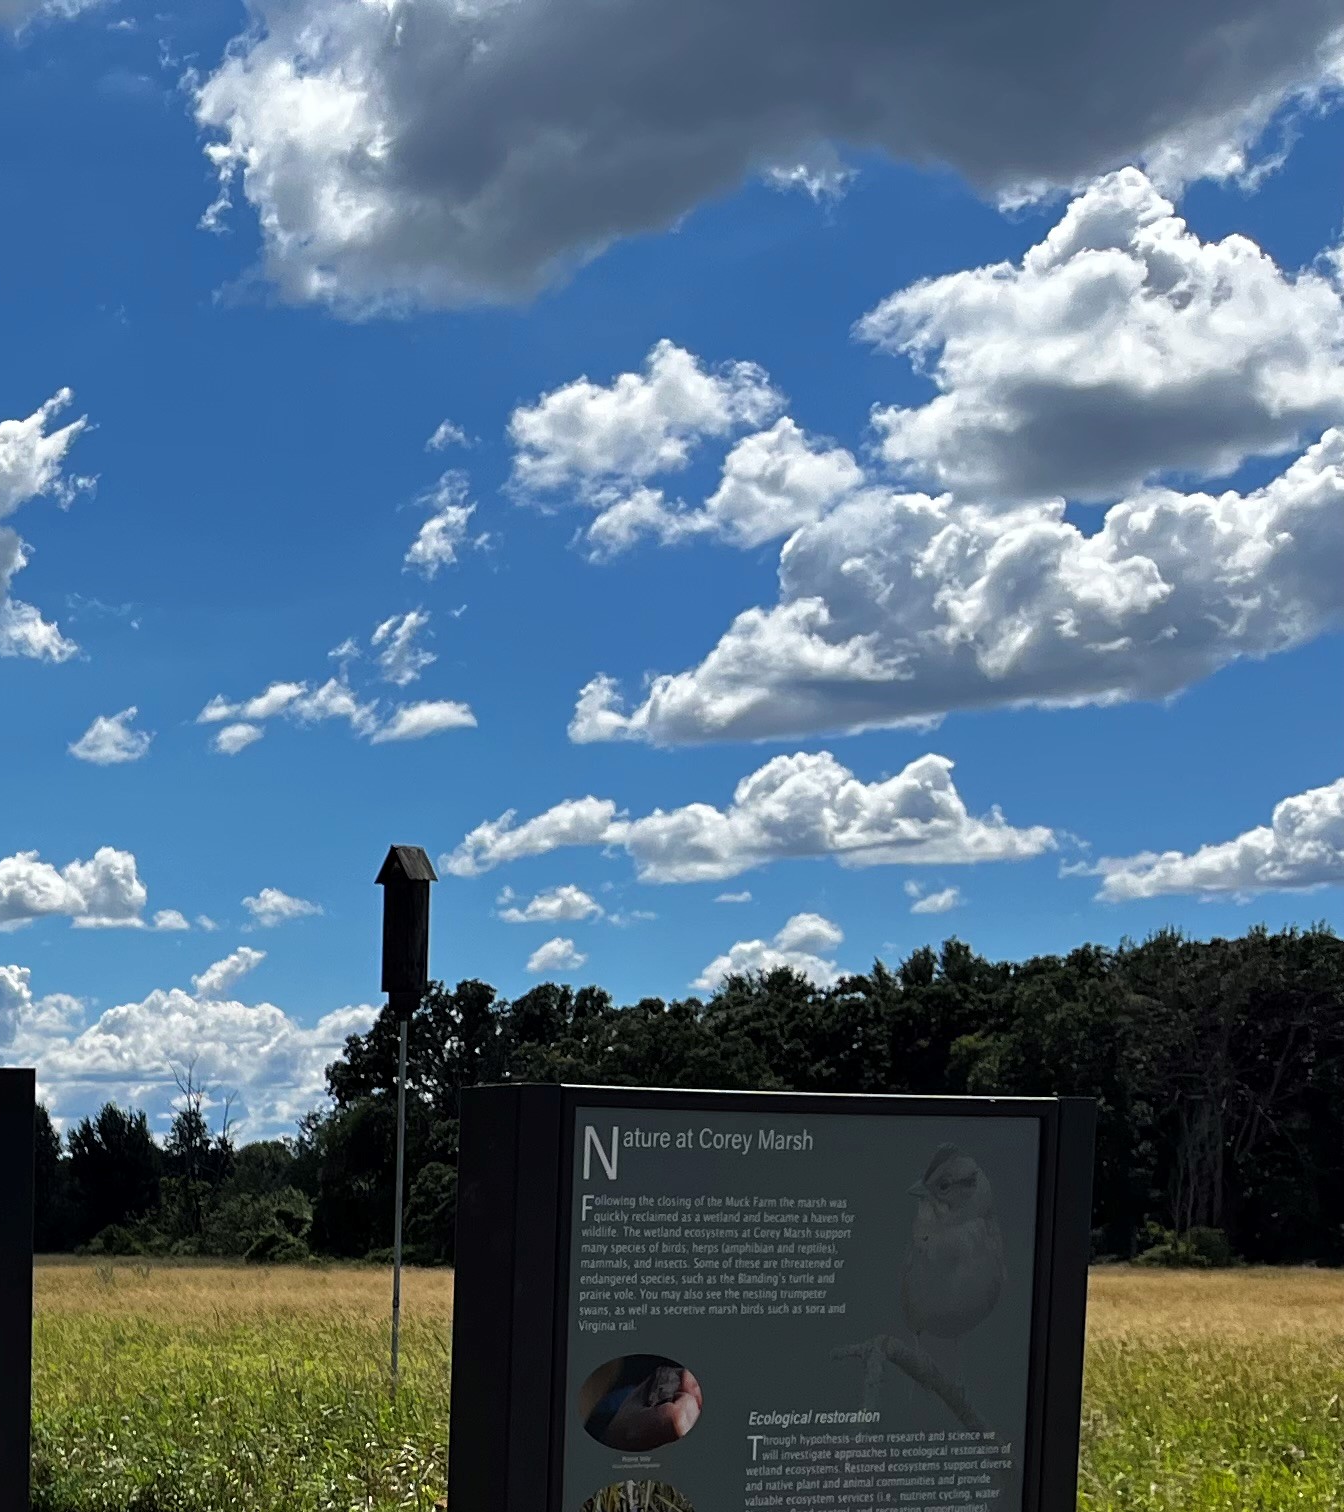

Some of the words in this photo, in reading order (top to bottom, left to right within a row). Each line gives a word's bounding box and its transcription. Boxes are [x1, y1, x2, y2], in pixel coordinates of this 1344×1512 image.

[675, 1127, 693, 1150] at
[698, 1127, 752, 1155] Corey
[757, 1128, 813, 1151] Marsh
[578, 1319, 616, 1334] Virginia
[748, 1408, 812, 1429] Ecological
[814, 1407, 880, 1424] restoration
